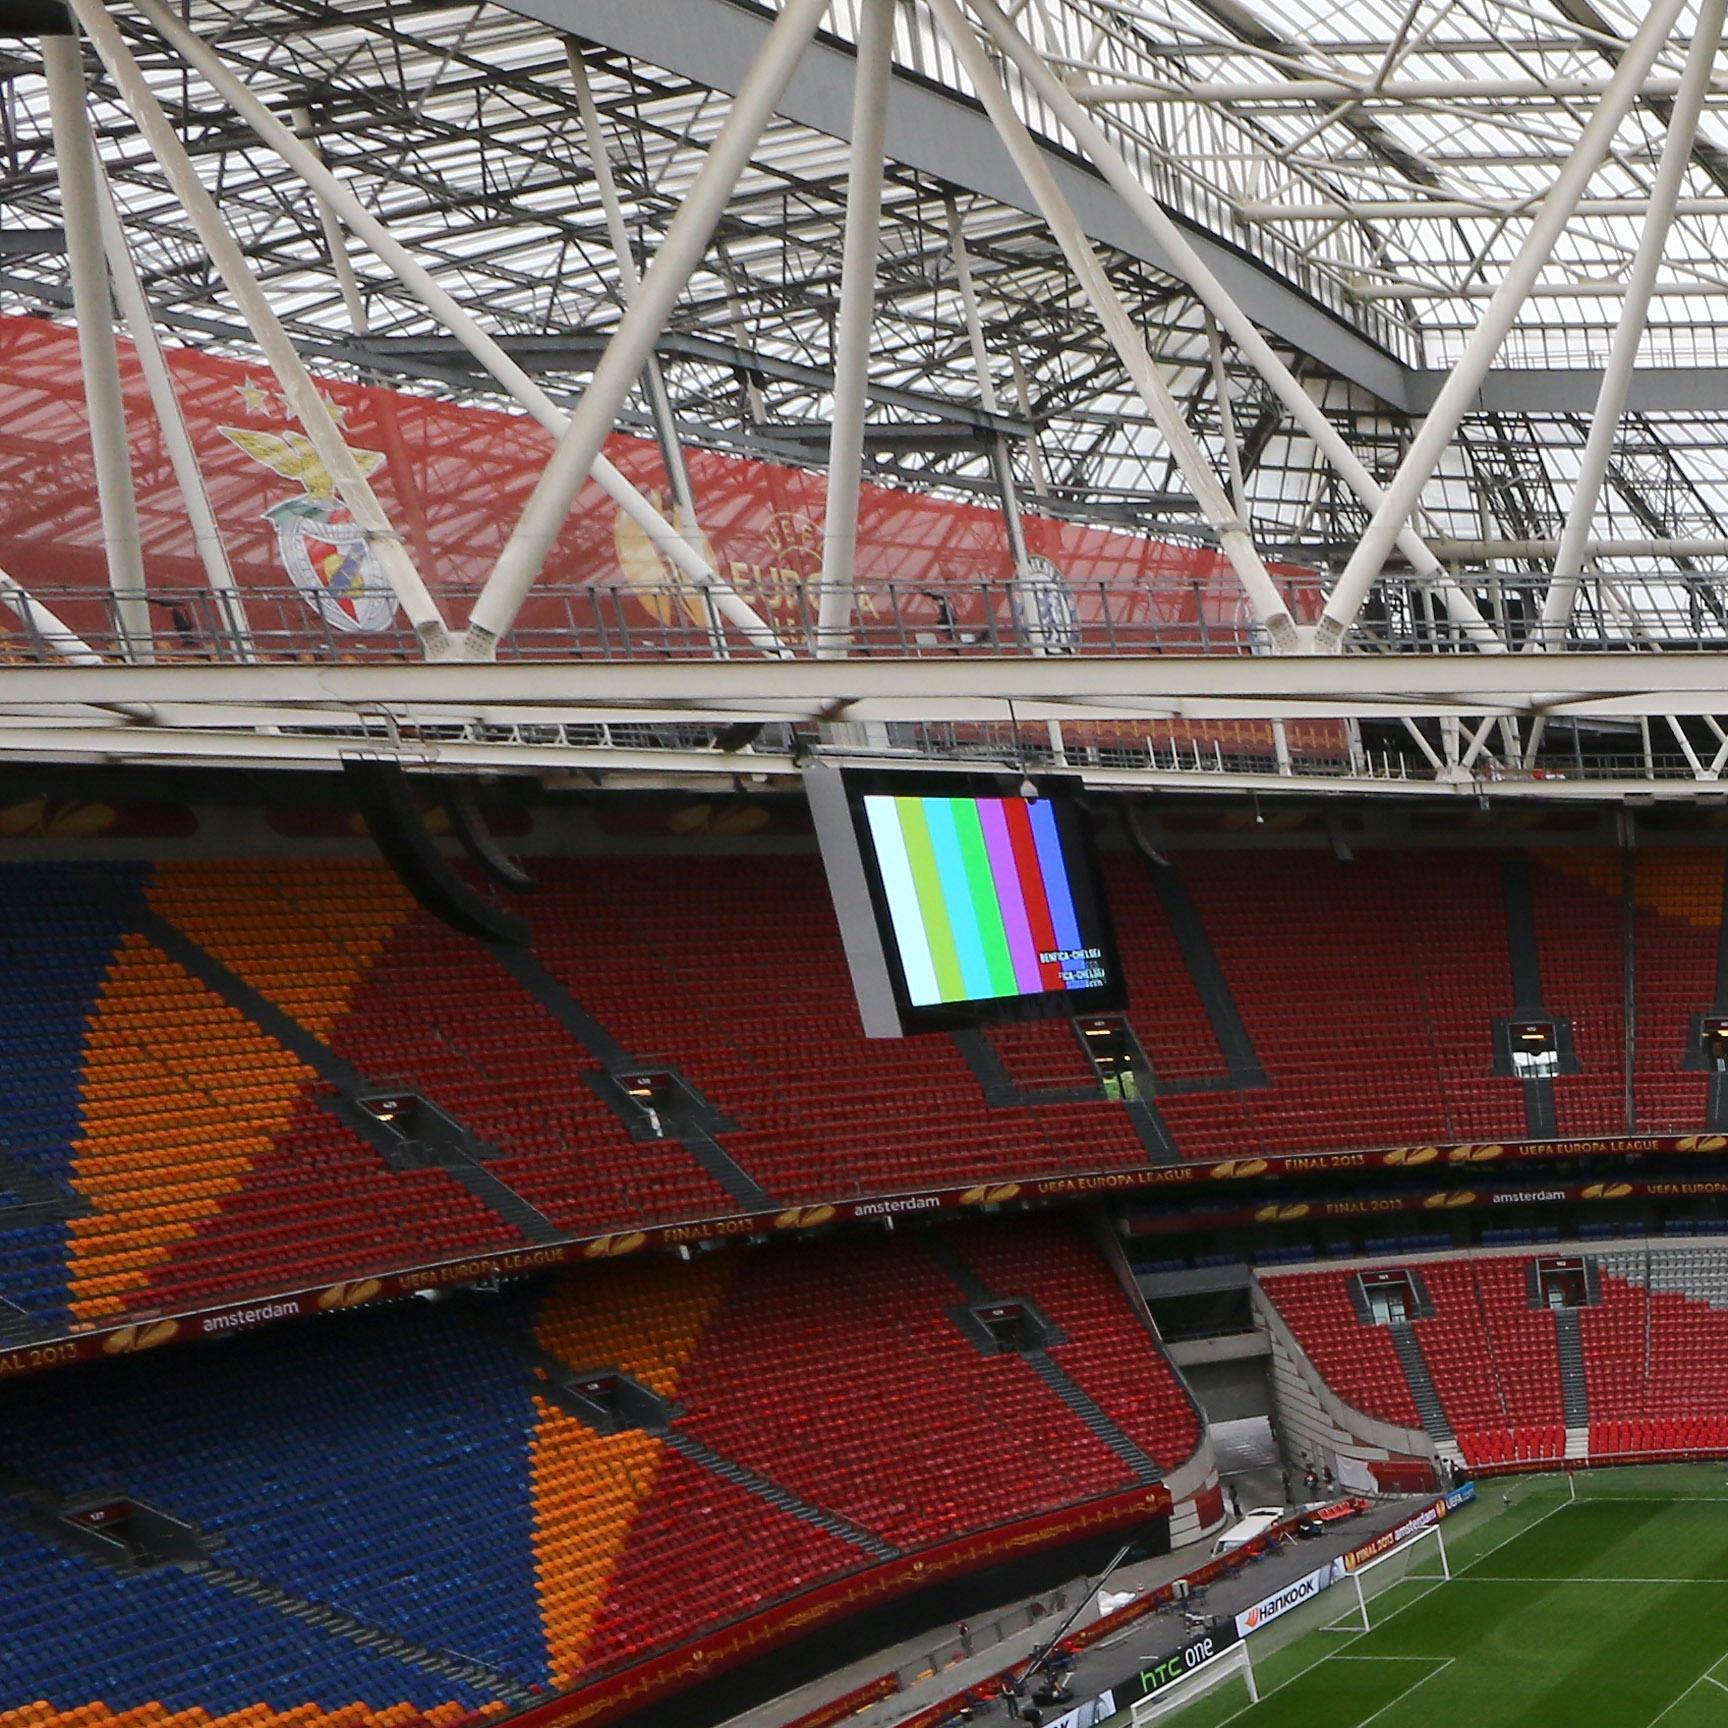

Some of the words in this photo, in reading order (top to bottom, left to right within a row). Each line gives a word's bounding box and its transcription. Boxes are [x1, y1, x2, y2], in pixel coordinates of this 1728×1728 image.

[1519, 1143, 1554, 1157] UEFA
[1556, 1141, 1607, 1155] EUROPA
[1611, 1139, 1659, 1152] LEAGUE
[1285, 1155, 1328, 1171] FINAL
[1332, 1154, 1364, 1167] 2013
[1038, 1180, 1075, 1194] UEFA
[1078, 1174, 1135, 1190] EUROPA
[1138, 1168, 1192, 1184] LEAGUE
[1648, 1184, 1680, 1195] UEFA
[1681, 1182, 1728, 1194] EUROPA
[854, 1195, 940, 1218] amsterdam
[1326, 1202, 1368, 1215] FINAL
[1371, 1199, 1402, 1212] 2013
[1493, 1189, 1565, 1204] amsterdam
[663, 1225, 711, 1244] FINAL
[716, 1218, 754, 1236] 2013
[504, 1248, 564, 1271] LEAGUE
[203, 1301, 300, 1332] amsterdam
[32, 1343, 78, 1366] 2013
[1185, 1637, 1213, 1667] one
